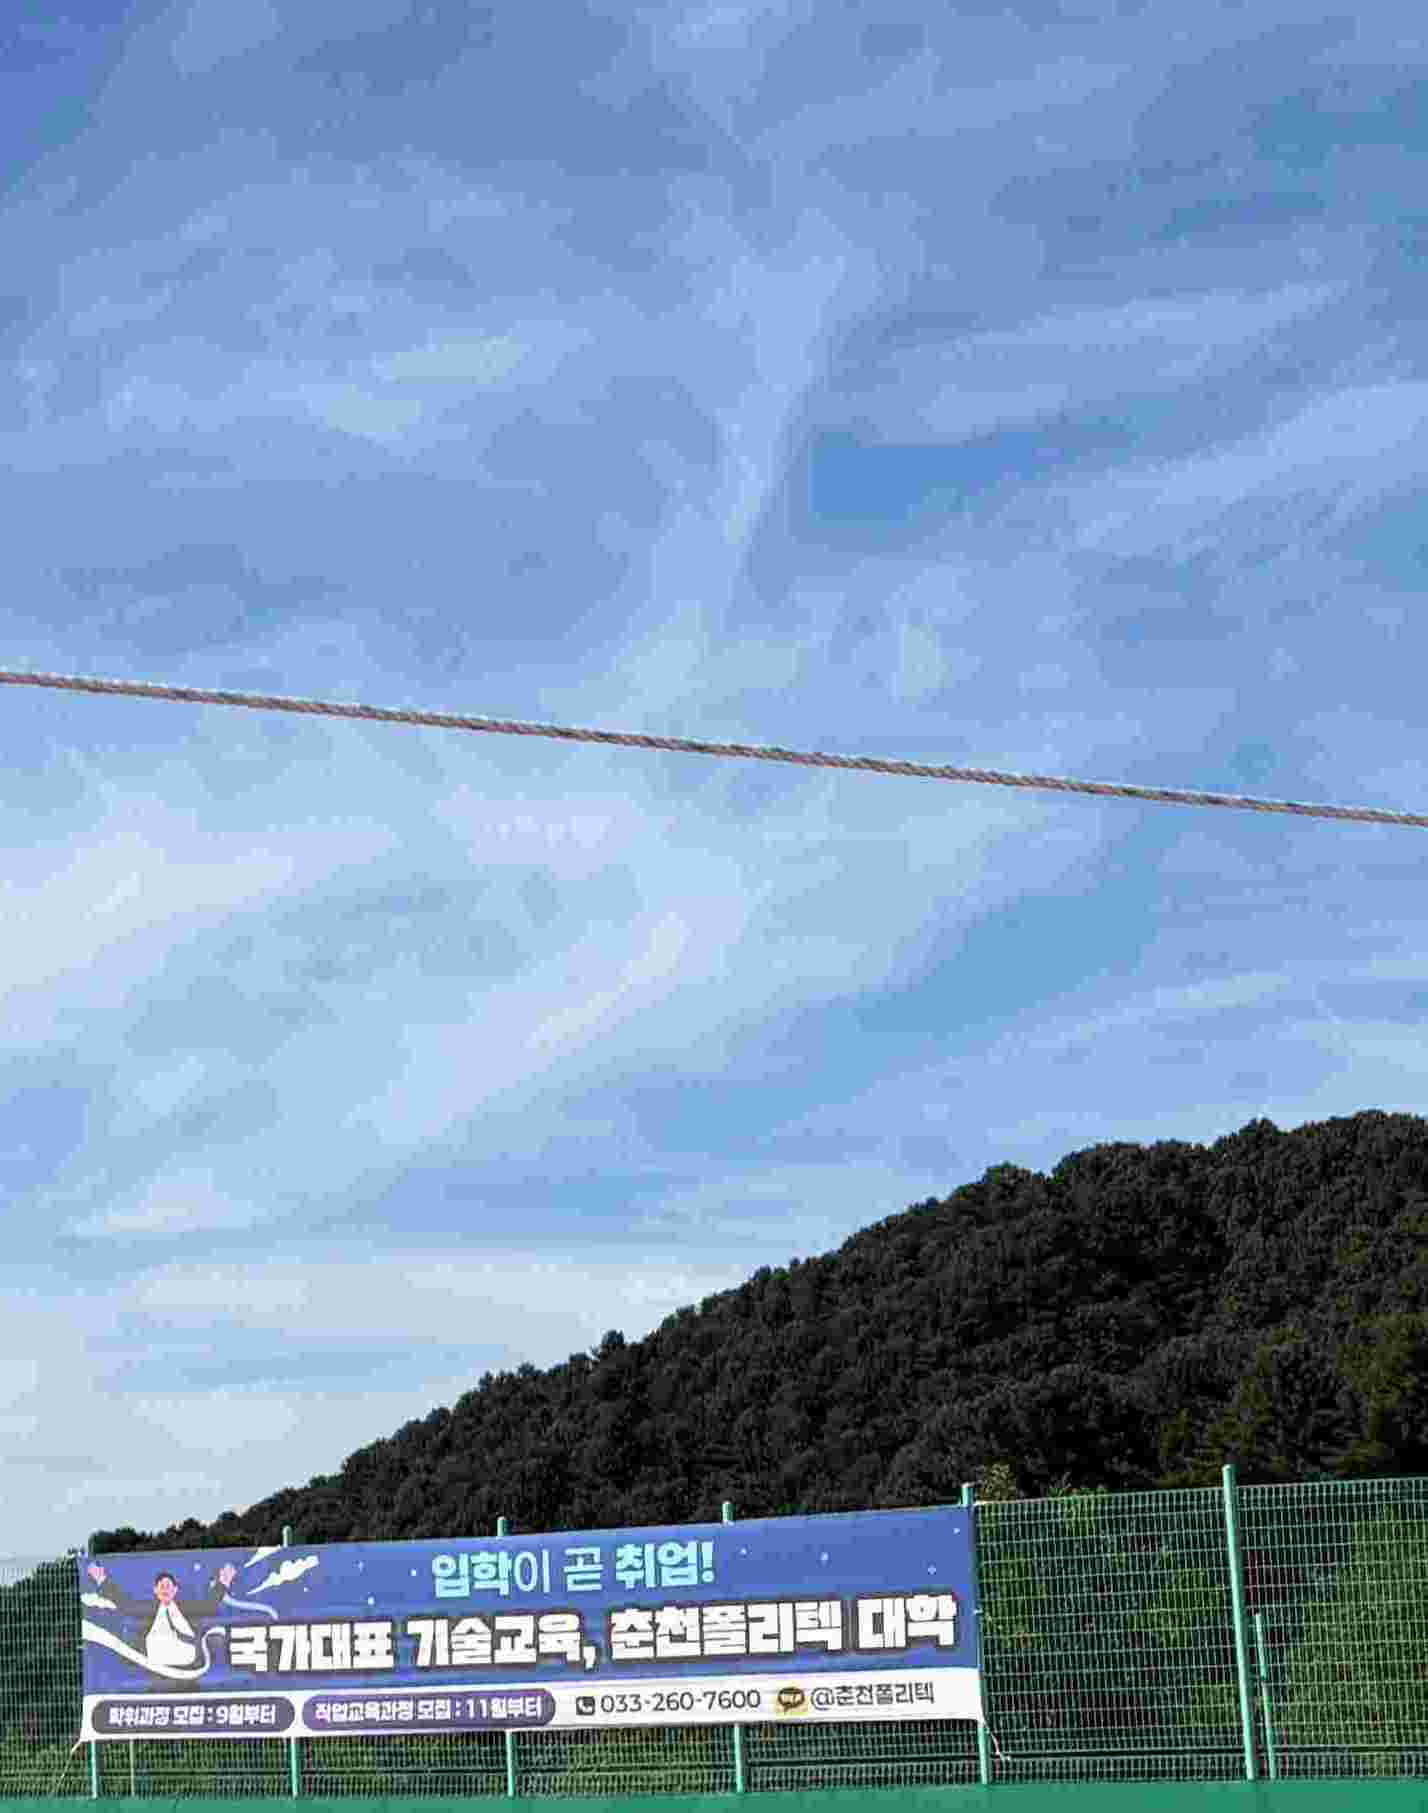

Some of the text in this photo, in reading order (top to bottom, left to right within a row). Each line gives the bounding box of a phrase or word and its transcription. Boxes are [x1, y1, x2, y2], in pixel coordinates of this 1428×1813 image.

[431, 1541, 715, 1599] 입학이 곧 취업!
[229, 1594, 957, 1672] 국가대표 기술교육, 춘천폴리텍 대학
[172, 1705, 205, 1725] 모집
[215, 1703, 277, 1726] 9월부터
[314, 1700, 415, 1722] 직업교육과정
[416, 1698, 452, 1720] 모집
[465, 1696, 543, 1719] 11월부터
[599, 1689, 761, 1714] 033-260-7600
